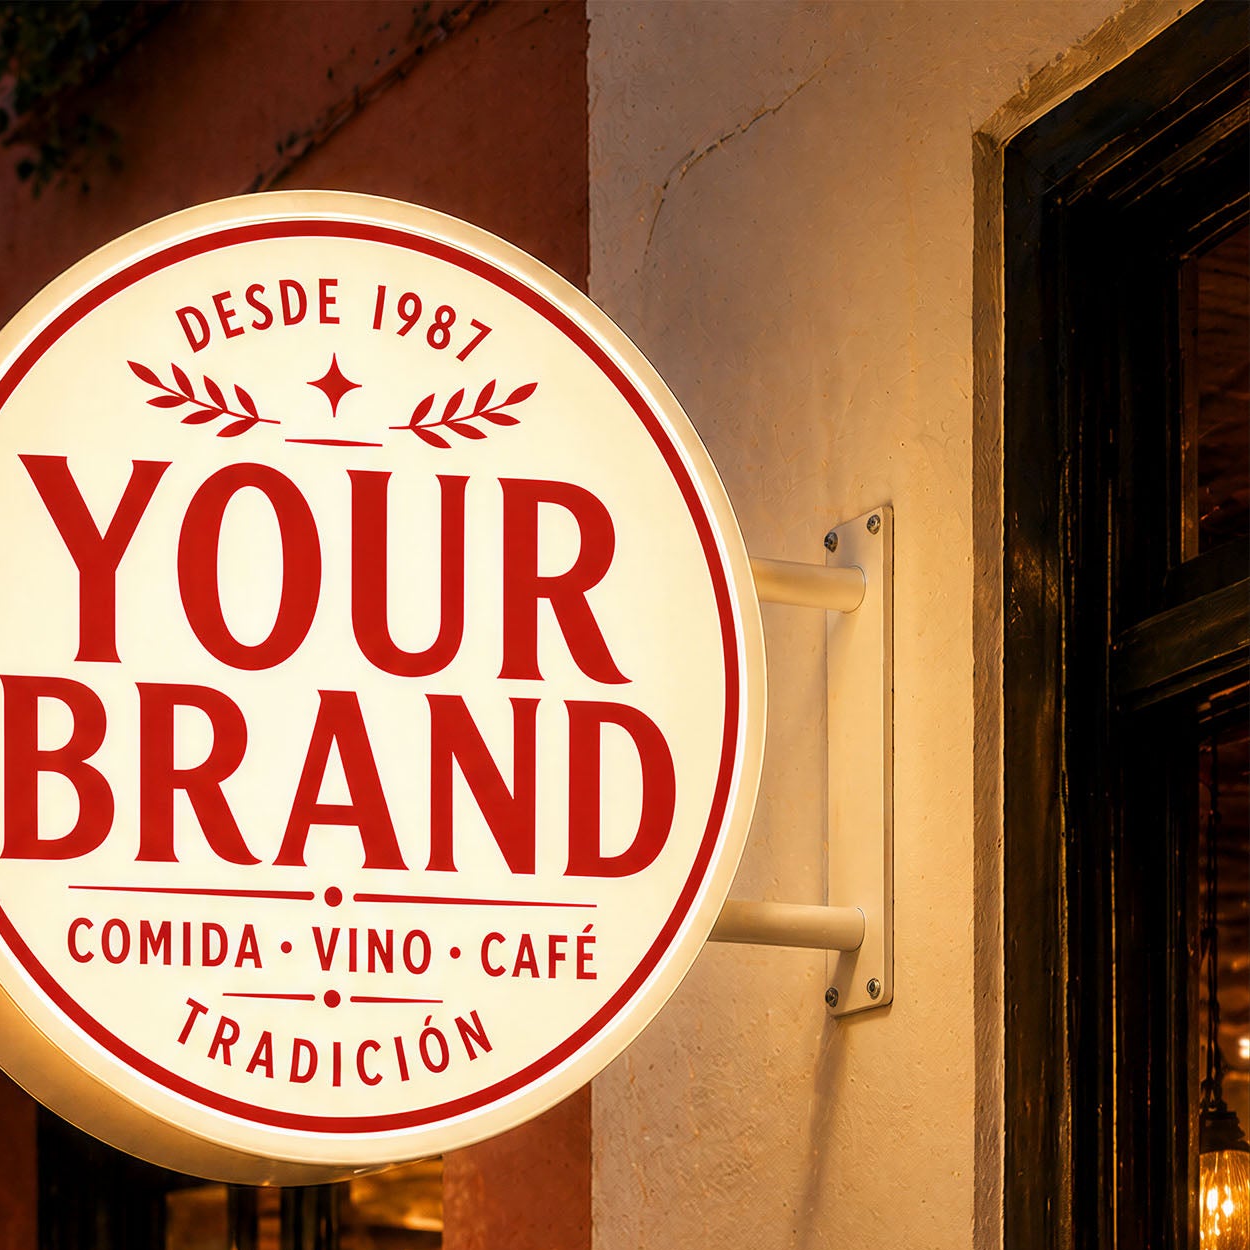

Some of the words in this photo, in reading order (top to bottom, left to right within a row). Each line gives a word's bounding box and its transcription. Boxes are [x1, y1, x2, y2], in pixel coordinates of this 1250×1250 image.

[175, 278, 341, 353] DESDE
[372, 284, 493, 362] 1987
[18, 454, 632, 685] YOUR
[0, 674, 677, 879] BRAND
[67, 917, 263, 969] COMIDA
[311, 927, 432, 975] VINO
[480, 923, 598, 981] CAFÉ
[176, 997, 493, 1087] TRADICIÓN
